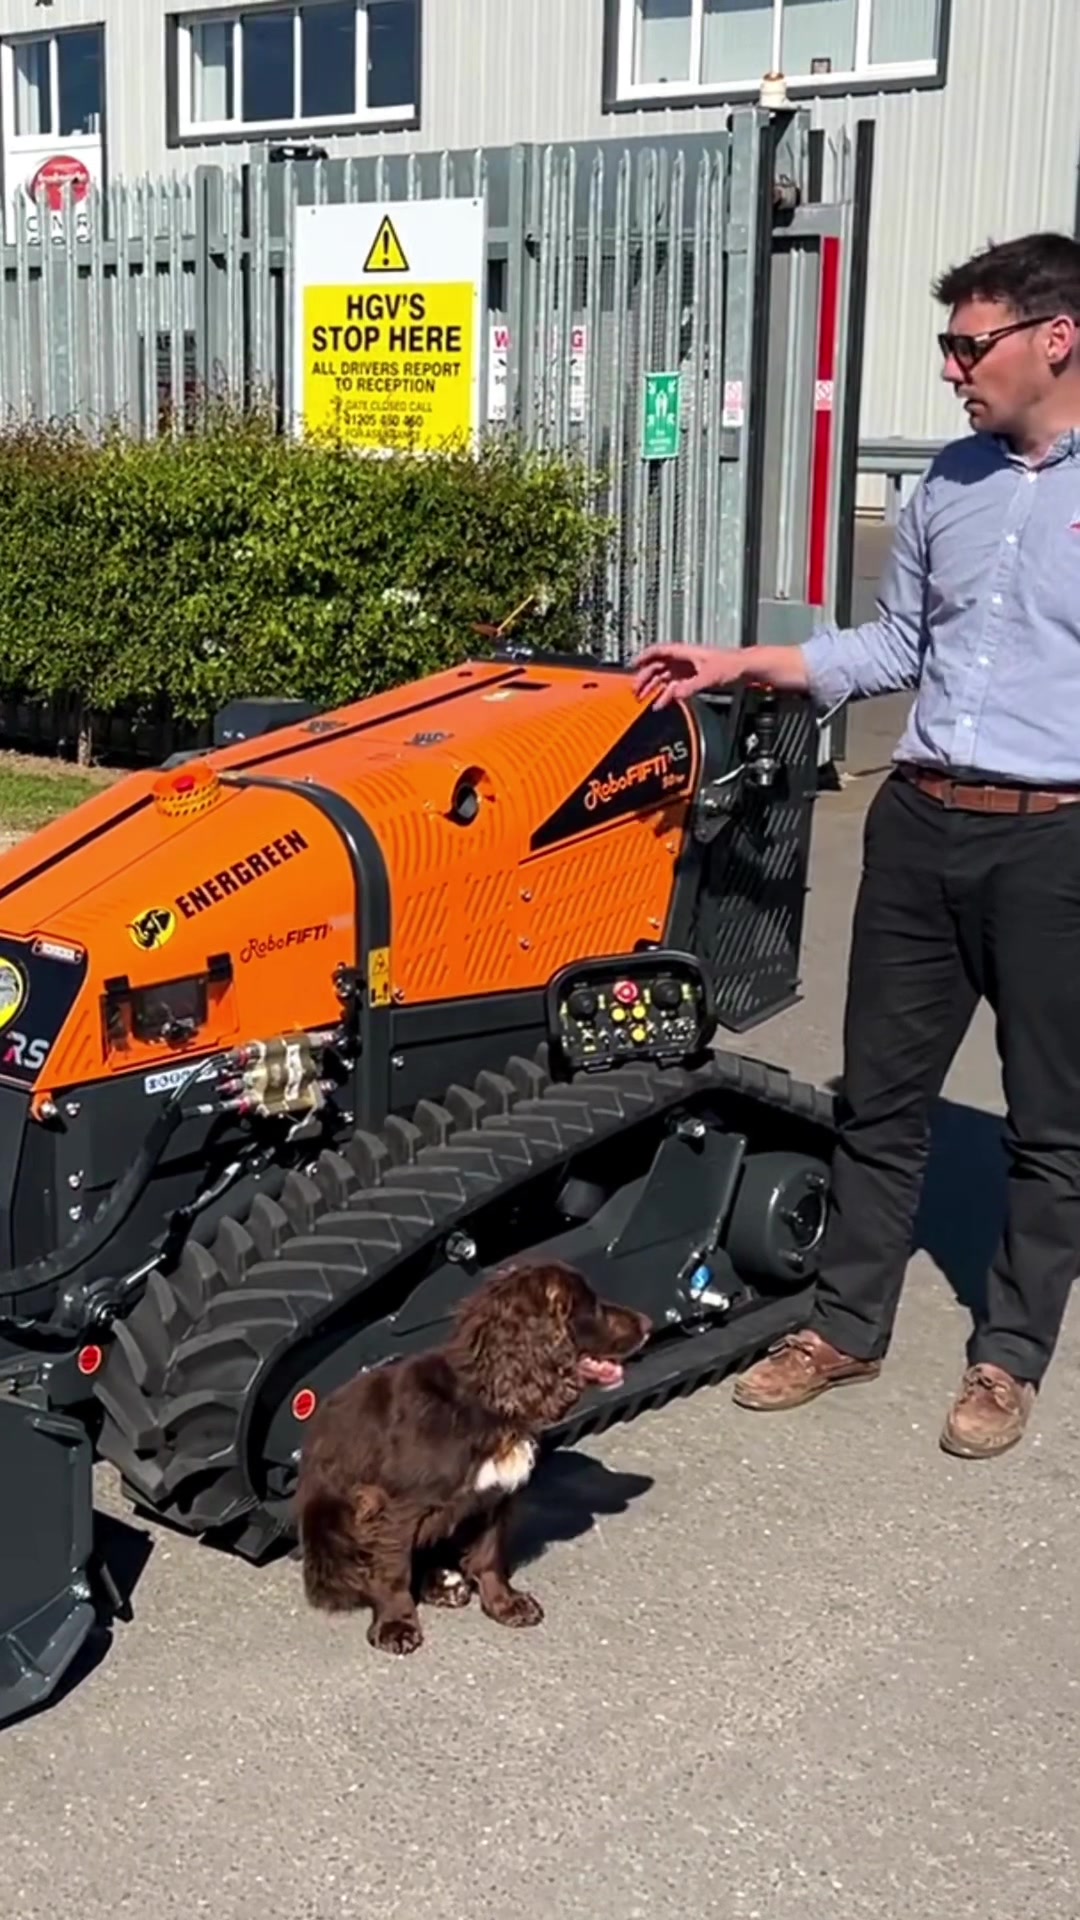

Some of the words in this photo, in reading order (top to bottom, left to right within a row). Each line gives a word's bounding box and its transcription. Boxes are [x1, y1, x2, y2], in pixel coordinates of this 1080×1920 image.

[347, 293, 426, 321] HGV'S
[312, 325, 381, 352] STOP
[389, 326, 462, 352] HERE
[312, 362, 336, 375] ALL
[341, 362, 399, 376] DRIVERS
[403, 362, 461, 377] REPORT
[335, 377, 353, 391] TO
[357, 378, 435, 393] RECEPTION
[370, 401, 407, 412] CLOSED
[409, 401, 433, 413] CALL
[174, 829, 309, 919] ENERGREEN
[4, 1031, 50, 1070] RS
